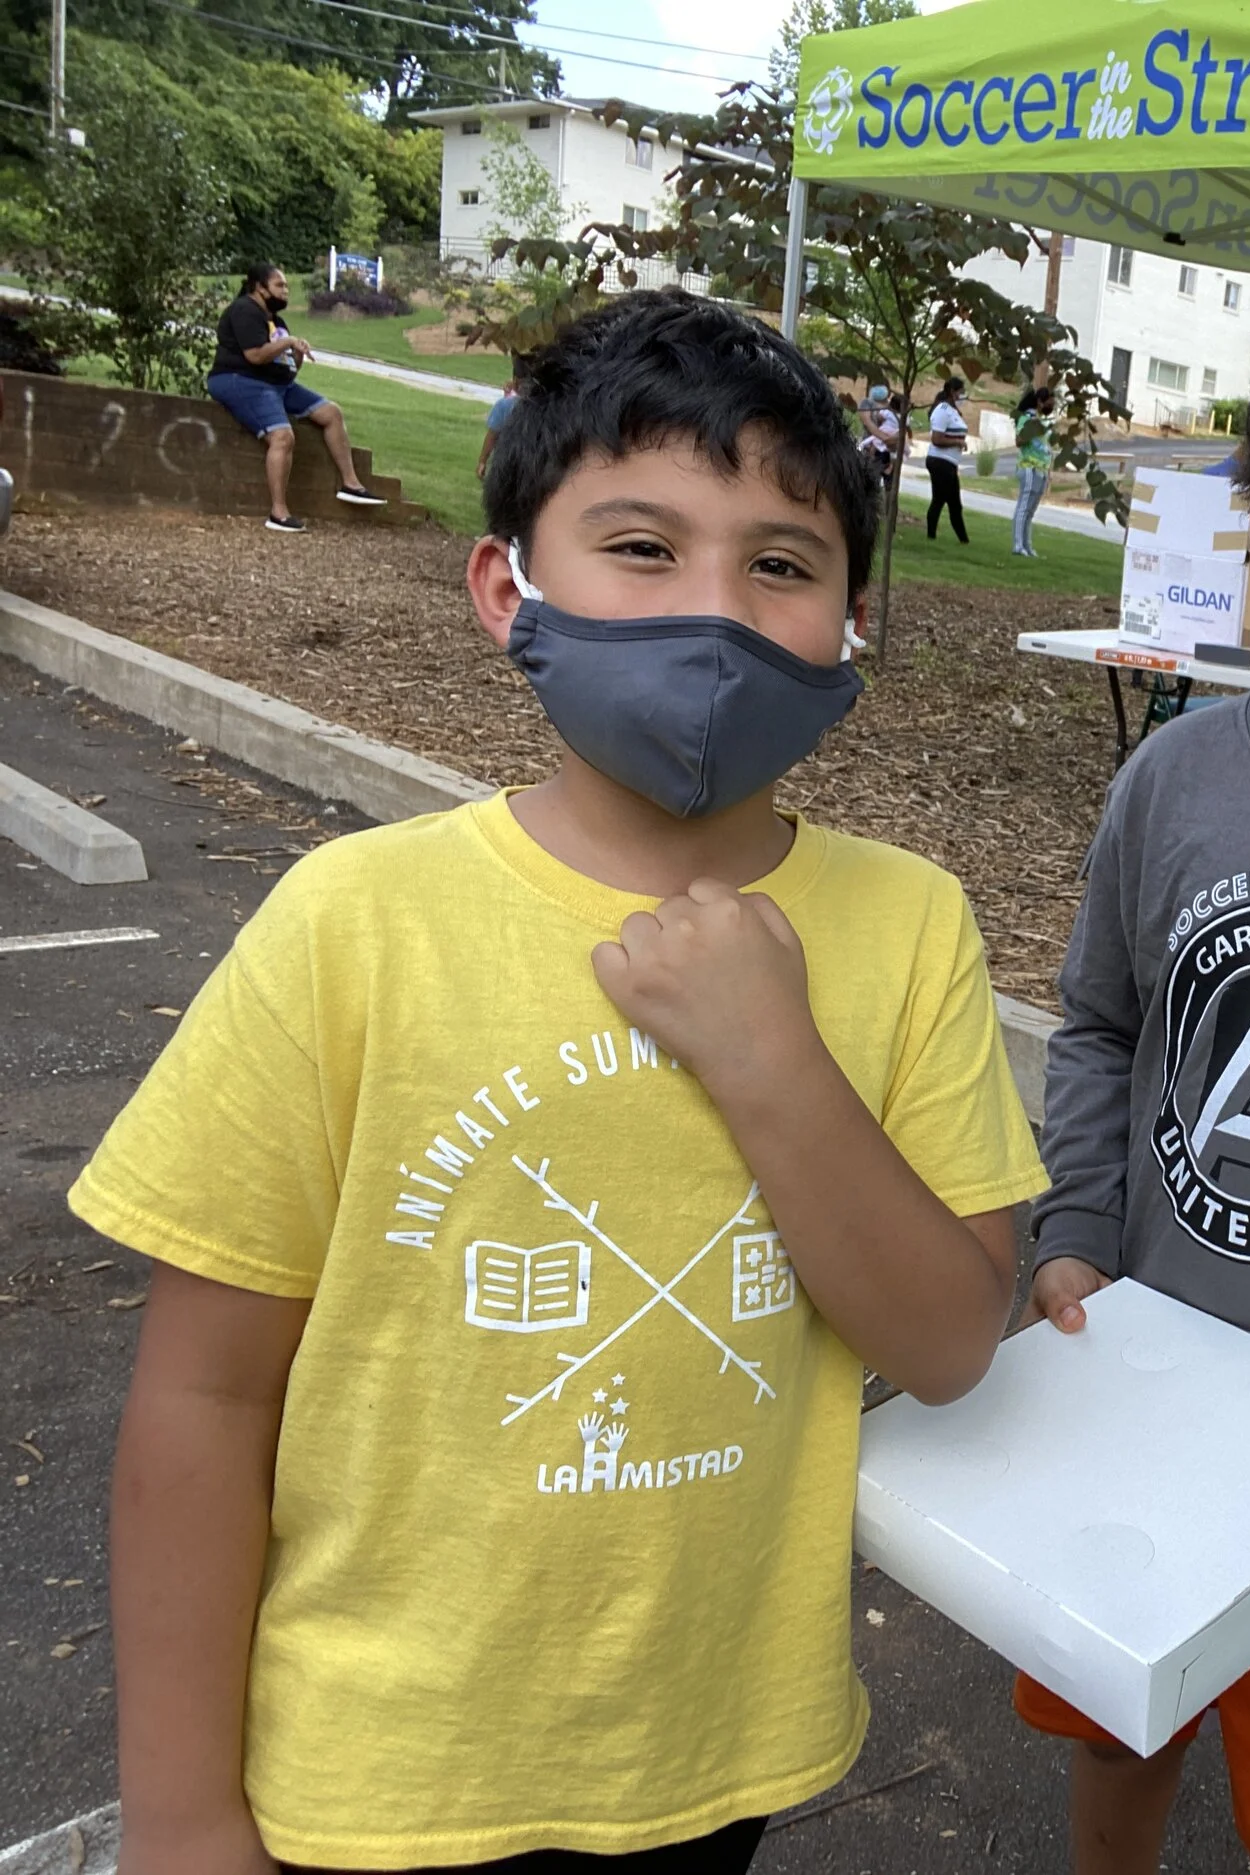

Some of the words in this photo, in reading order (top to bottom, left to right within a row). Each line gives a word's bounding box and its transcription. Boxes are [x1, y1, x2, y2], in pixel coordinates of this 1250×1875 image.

[1100, 50, 1132, 95] in
[858, 65, 1097, 149] Soccer
[1087, 93, 1134, 140] the
[1168, 585, 1231, 612] GILDAN
[385, 1064, 540, 1251] ANÍMATE
[558, 1027, 679, 1087] SUM
